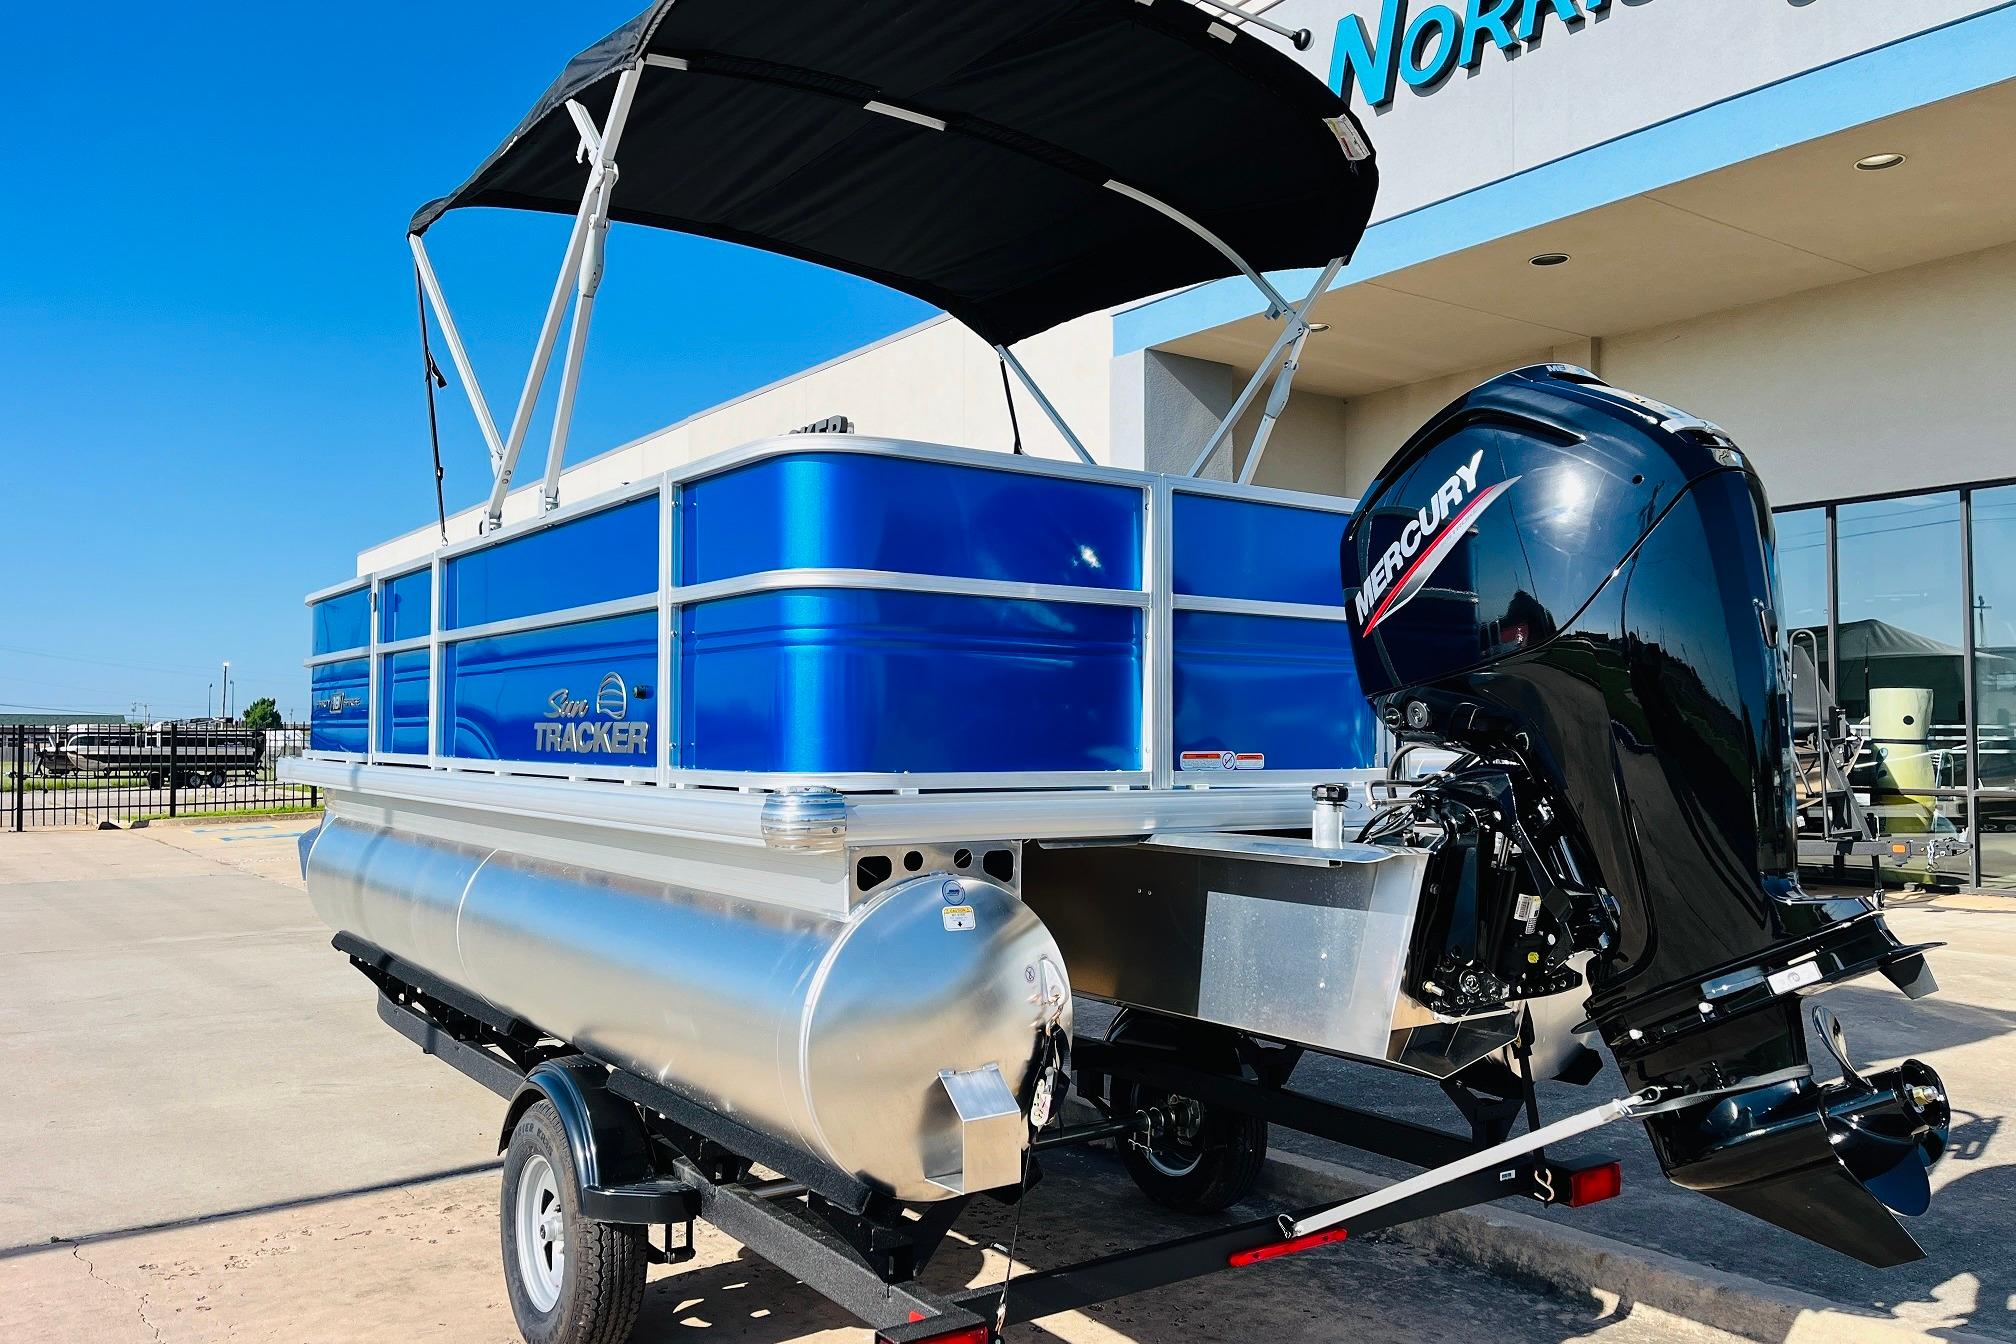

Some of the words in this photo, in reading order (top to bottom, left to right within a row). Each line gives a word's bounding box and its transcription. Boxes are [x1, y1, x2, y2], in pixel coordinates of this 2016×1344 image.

[1354, 449, 1484, 626] MERCURY
[544, 688, 588, 718] Sun
[534, 721, 649, 754] TRACKER
